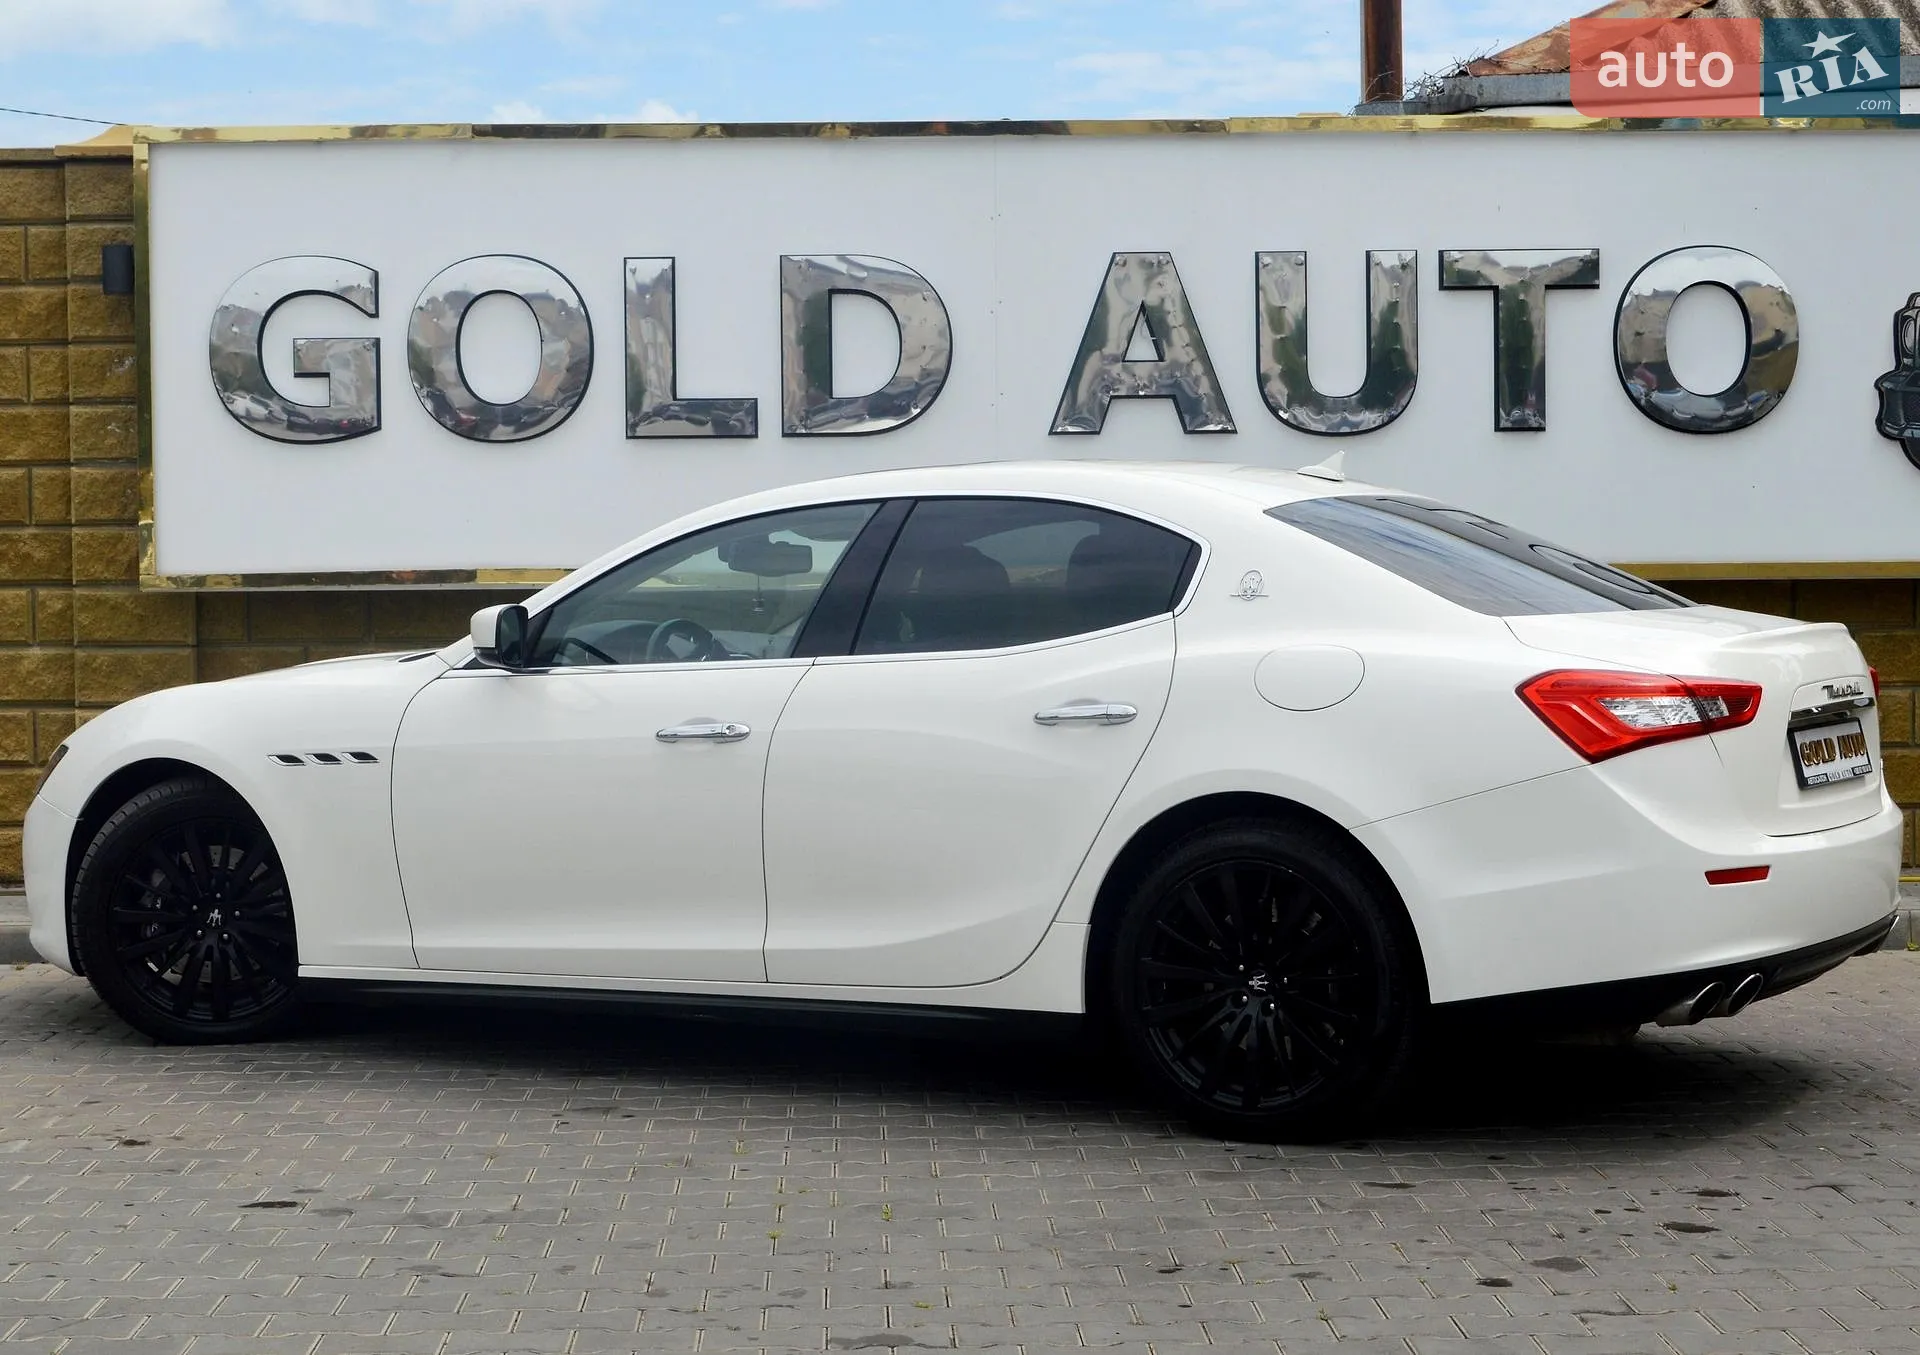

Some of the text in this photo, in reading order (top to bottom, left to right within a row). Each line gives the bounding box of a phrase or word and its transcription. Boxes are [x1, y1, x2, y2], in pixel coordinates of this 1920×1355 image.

[209, 245, 1801, 445] GOLD AUTO
[1800, 732, 1866, 767] GOLD AUTO
